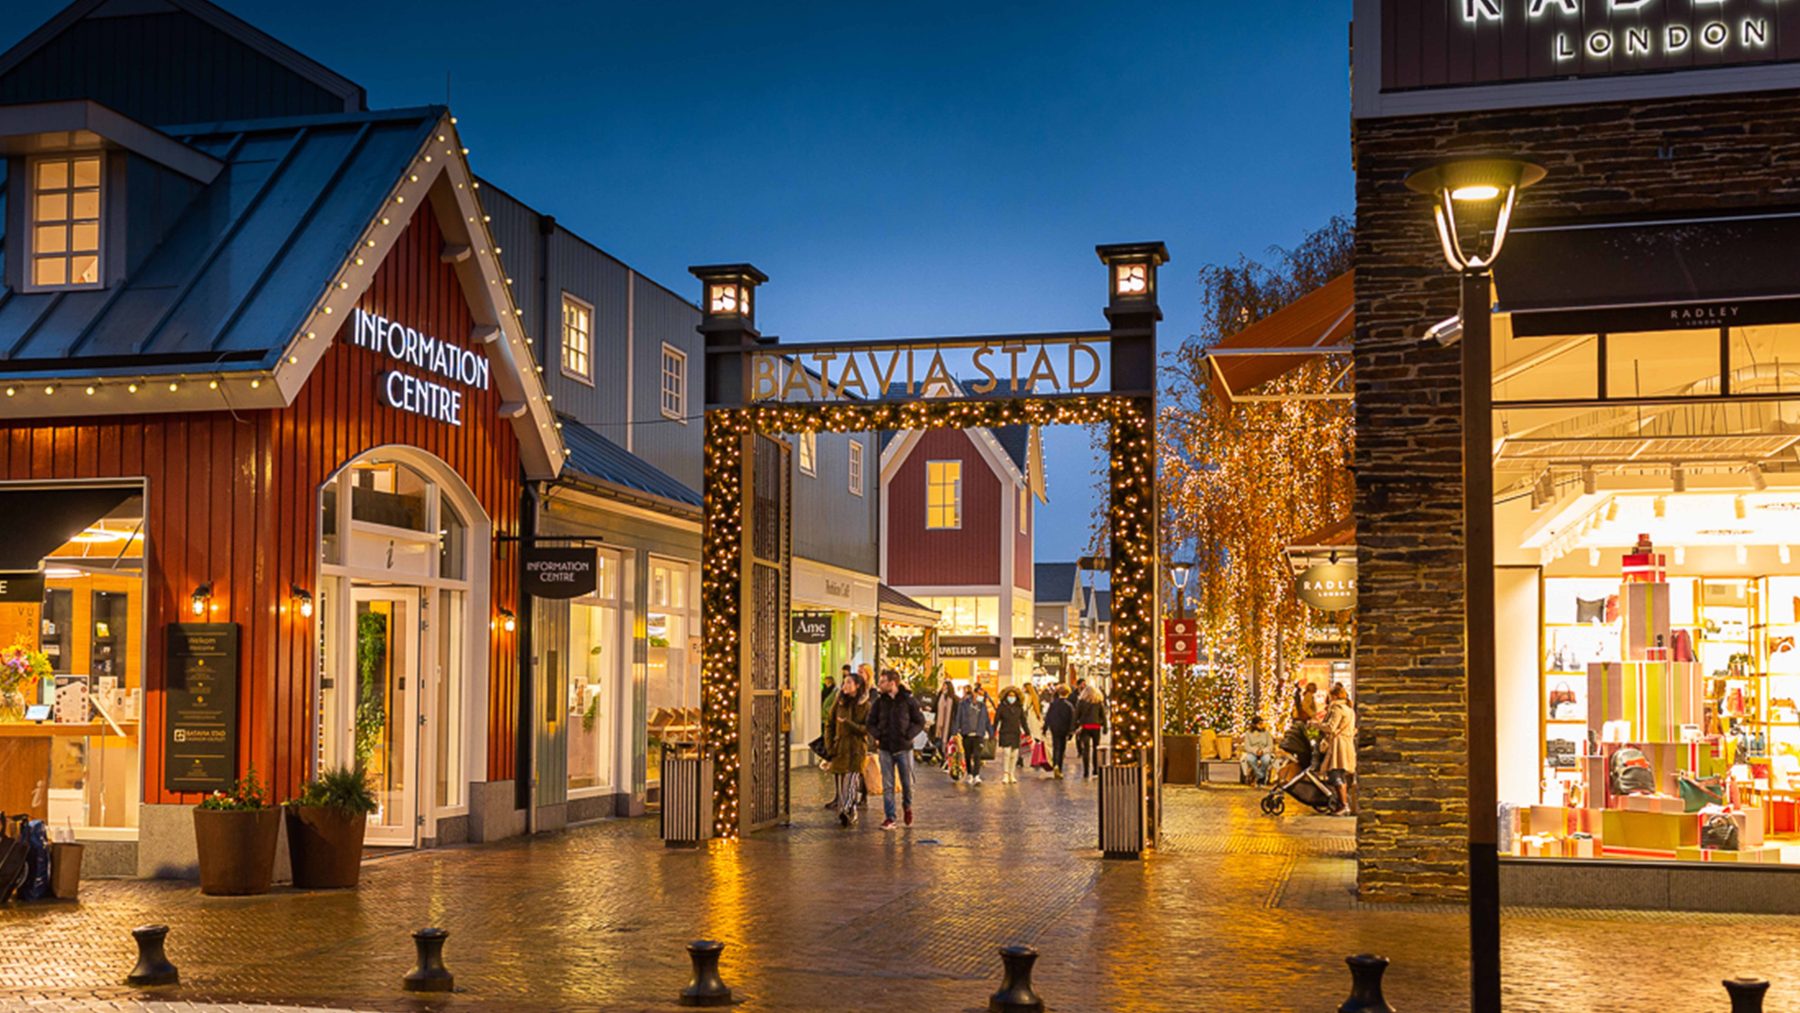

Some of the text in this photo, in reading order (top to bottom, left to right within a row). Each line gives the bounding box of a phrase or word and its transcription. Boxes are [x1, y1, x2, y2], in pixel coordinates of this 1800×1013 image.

[1558, 20, 1766, 57] LONDON
[1671, 306, 1739, 319] RADLEY
[354, 307, 489, 391] INFORMATION
[753, 343, 1101, 399] BATAVIA STAD
[386, 370, 462, 426] CENTRE
[526, 561, 590, 571] INFORMATION
[540, 572, 576, 582] CENTRE
[1303, 580, 1356, 591] RADLE
[796, 619, 826, 633] Ame
[939, 645, 977, 656] UWELIERS
